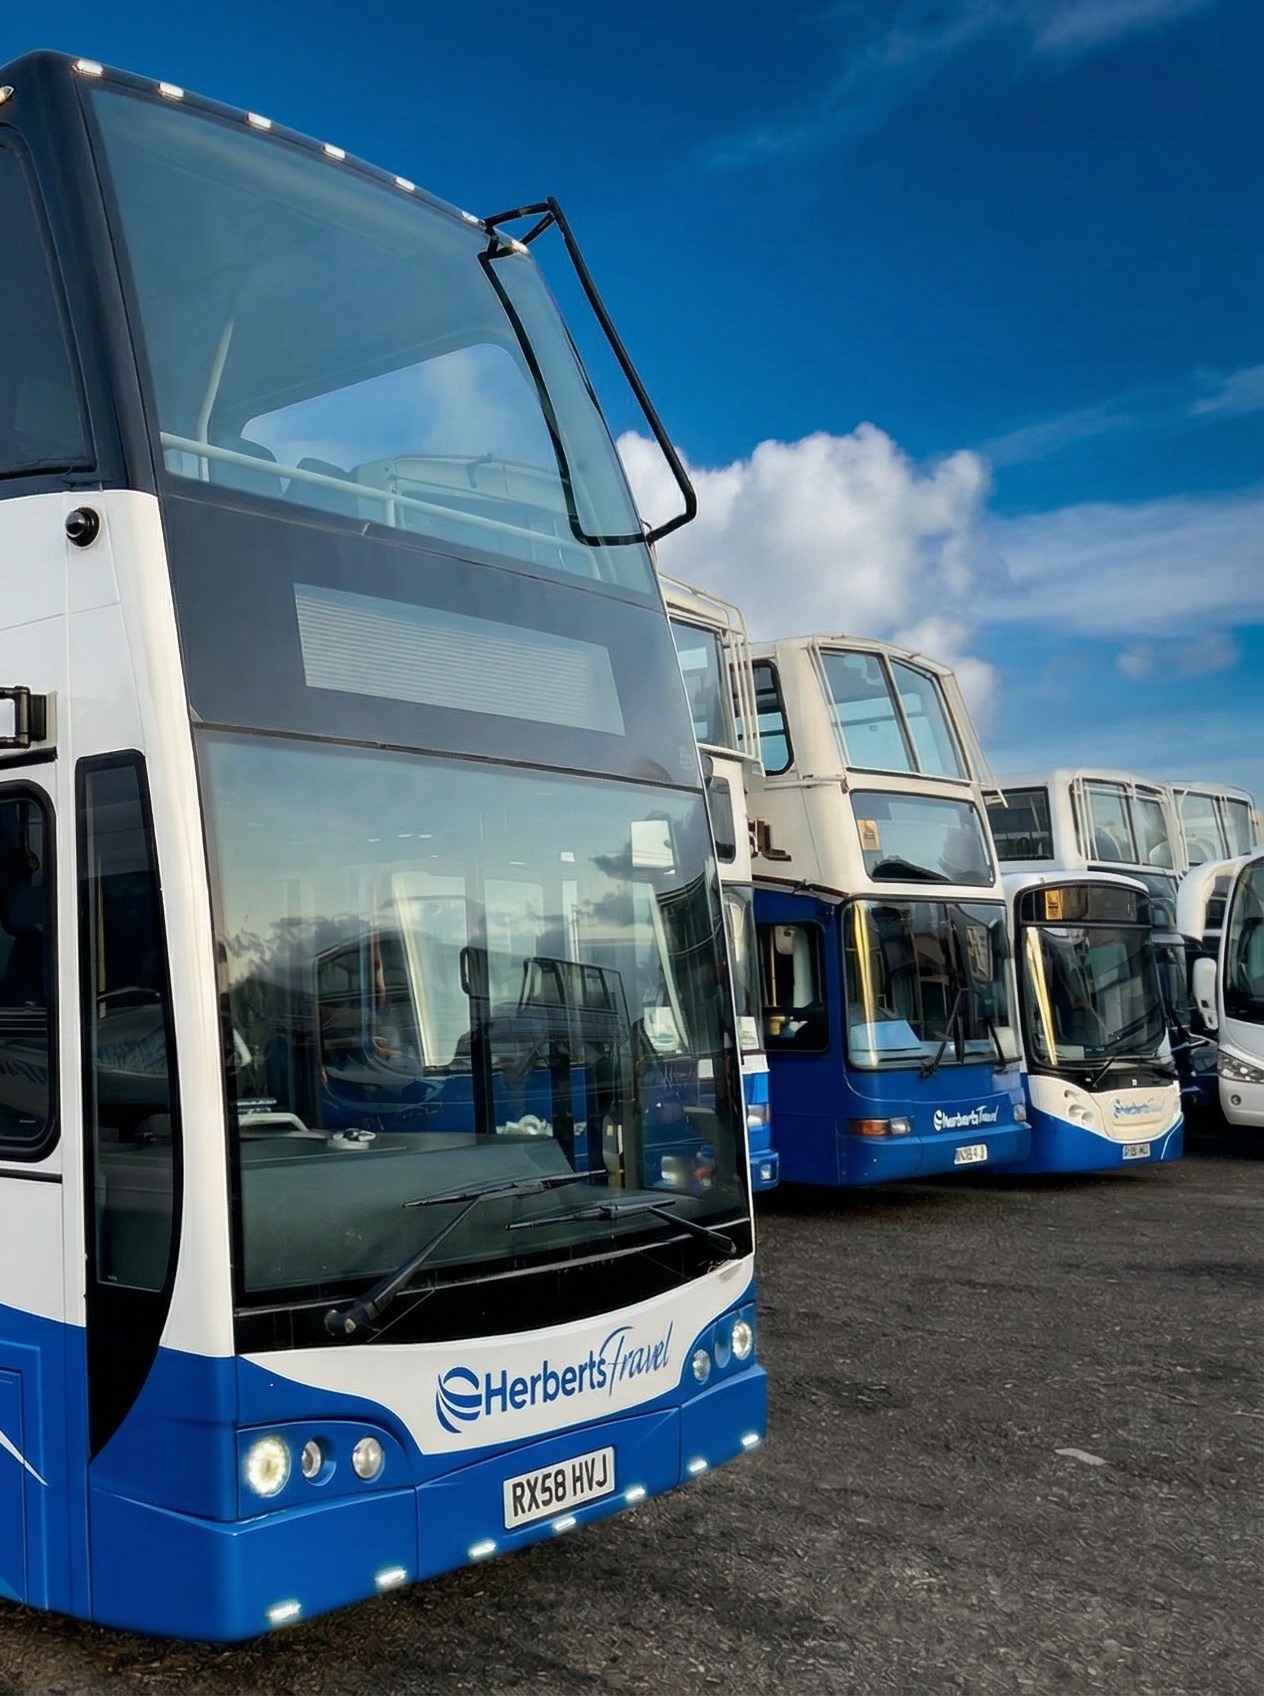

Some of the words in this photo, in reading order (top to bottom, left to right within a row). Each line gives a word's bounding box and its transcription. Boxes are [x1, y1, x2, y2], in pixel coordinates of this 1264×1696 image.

[484, 1350, 607, 1416] Herberts
[599, 1320, 674, 1397] Travel
[511, 1468, 567, 1518] RX58
[571, 1453, 608, 1497] HVJ
